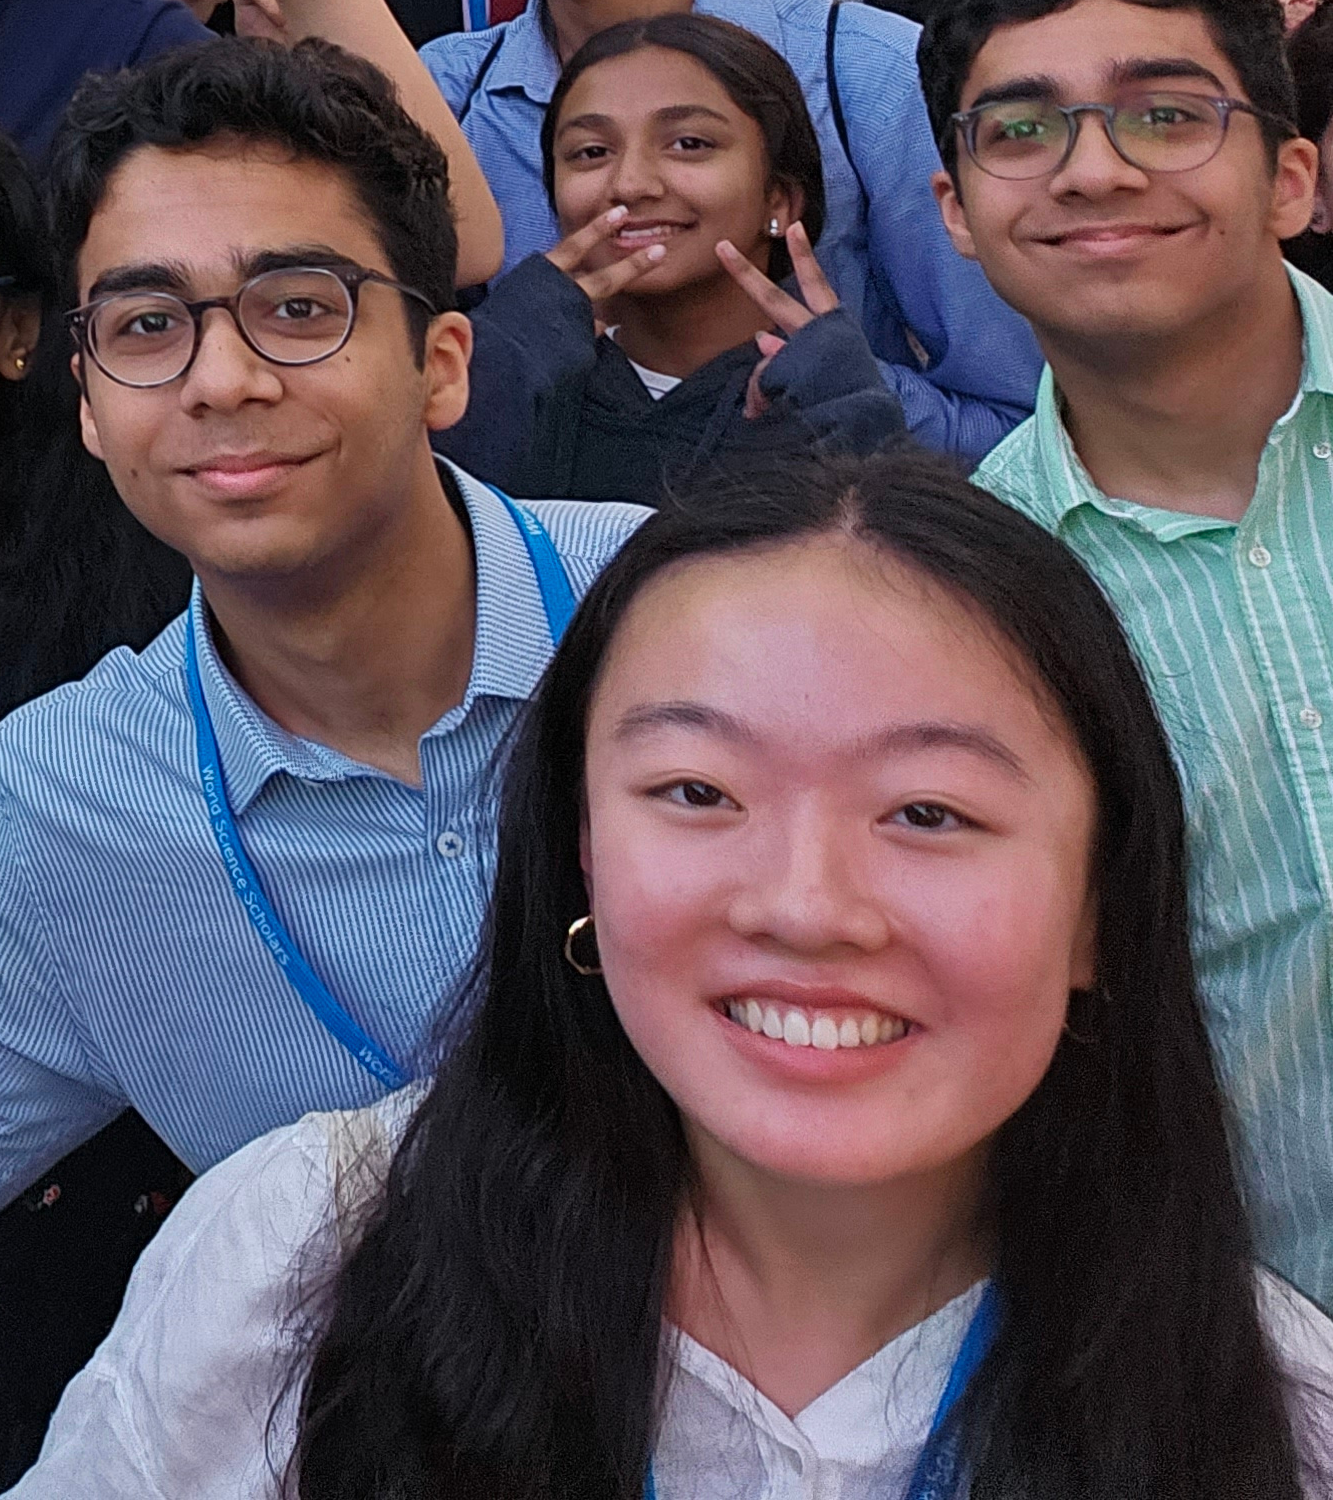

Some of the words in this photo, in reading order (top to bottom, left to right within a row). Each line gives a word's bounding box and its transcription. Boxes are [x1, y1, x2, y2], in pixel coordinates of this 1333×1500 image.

[201, 764, 223, 816] World
[215, 817, 247, 889] Science
[244, 891, 291, 966] Scholars
